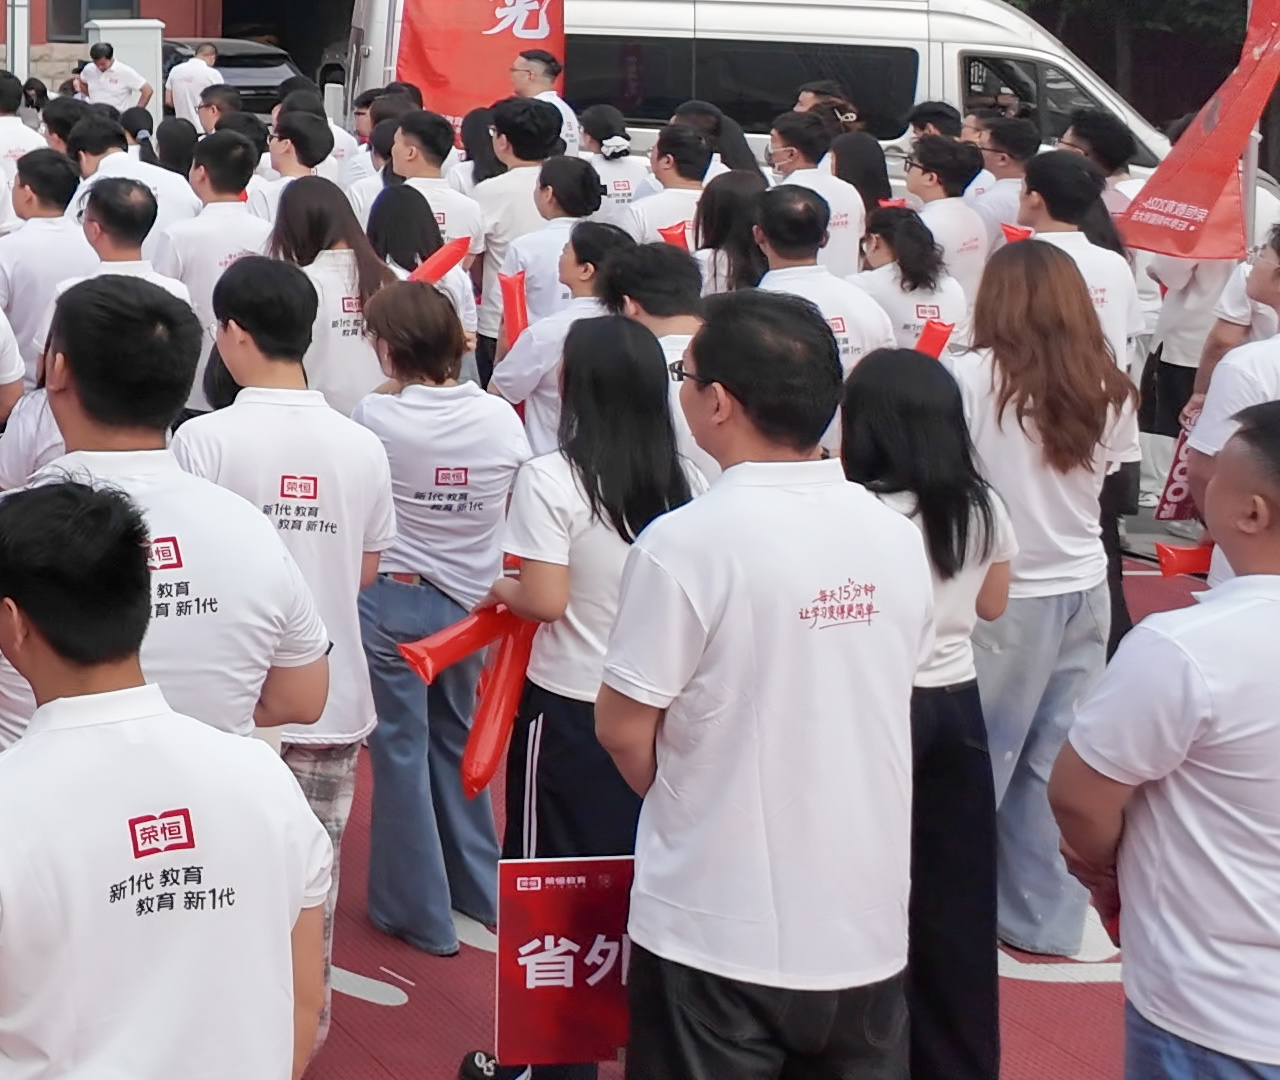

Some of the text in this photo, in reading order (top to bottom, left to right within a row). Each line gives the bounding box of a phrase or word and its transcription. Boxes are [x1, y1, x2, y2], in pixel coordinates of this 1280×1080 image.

[306, 520, 337, 534] 新1代
[156, 581, 190, 599] 教育
[176, 597, 218, 617] 新1代
[140, 821, 183, 846] 荣恒
[109, 866, 203, 904] 新1代 教育
[136, 887, 235, 916] 教育 新1代
